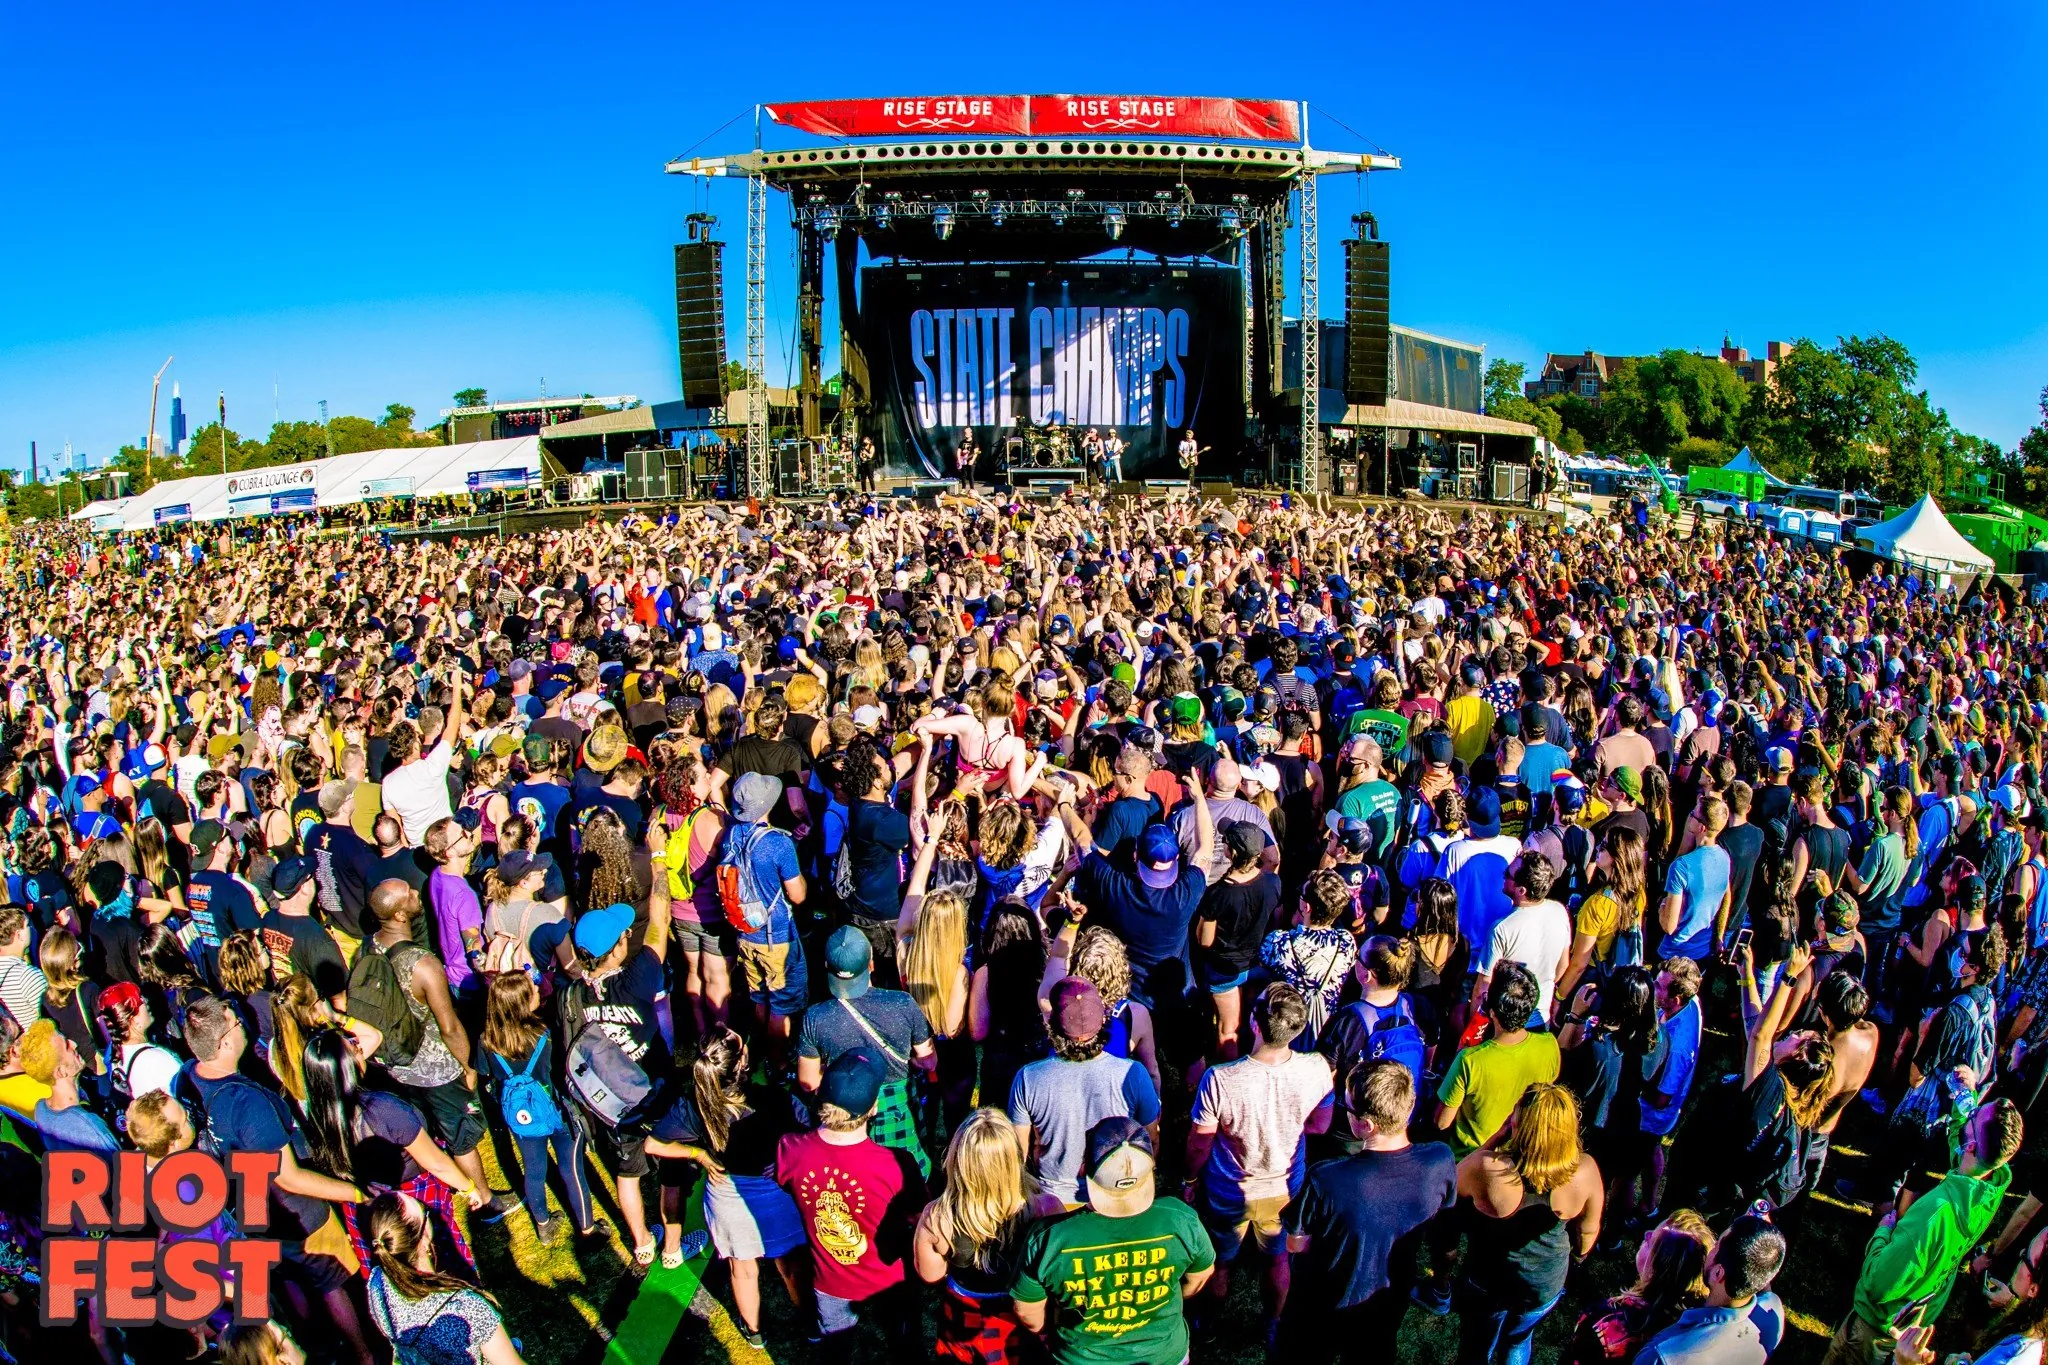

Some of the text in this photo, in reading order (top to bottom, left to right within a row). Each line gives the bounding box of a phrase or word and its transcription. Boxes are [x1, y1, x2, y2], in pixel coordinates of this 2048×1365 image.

[883, 101, 992, 116] RISE STAGE
[1067, 100, 1176, 117] RISE STAGE
[911, 306, 1189, 429] STATE CHAMPS
[239, 471, 299, 491] COBRA LOUNGE
[264, 931, 293, 951] RIOT
[601, 1005, 643, 1025] DEATH
[1072, 1247, 1167, 1275] I KEEP
[1064, 1266, 1175, 1293] MY FIST
[1073, 1284, 1170, 1309] RAISED
[1103, 1306, 1138, 1321] UP
